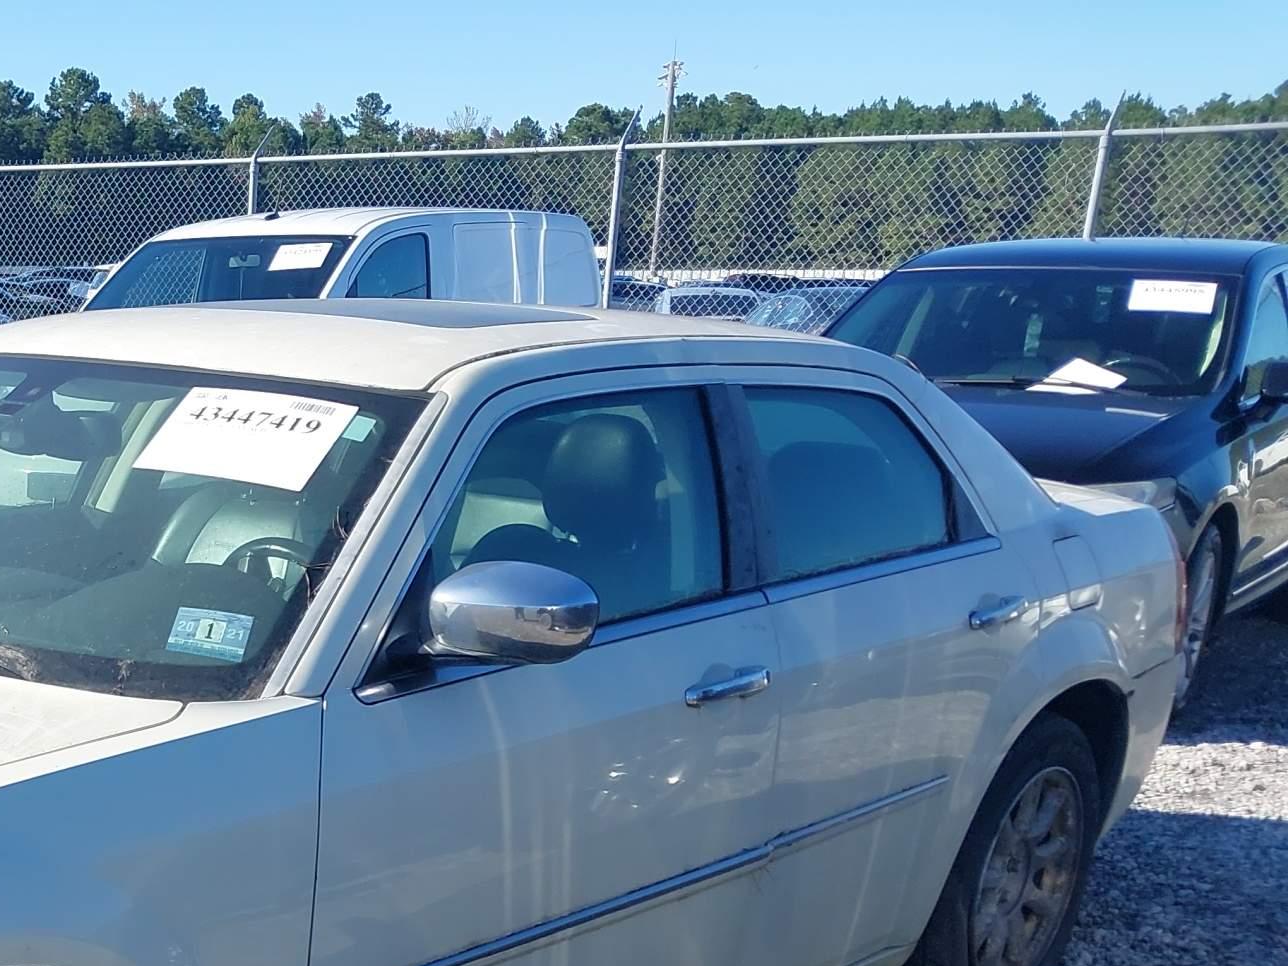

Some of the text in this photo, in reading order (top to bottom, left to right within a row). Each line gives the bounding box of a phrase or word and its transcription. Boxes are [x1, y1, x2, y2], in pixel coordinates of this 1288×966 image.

[189, 405, 322, 434] 43447419
[176, 620, 194, 632] 20
[204, 622, 215, 640] 1
